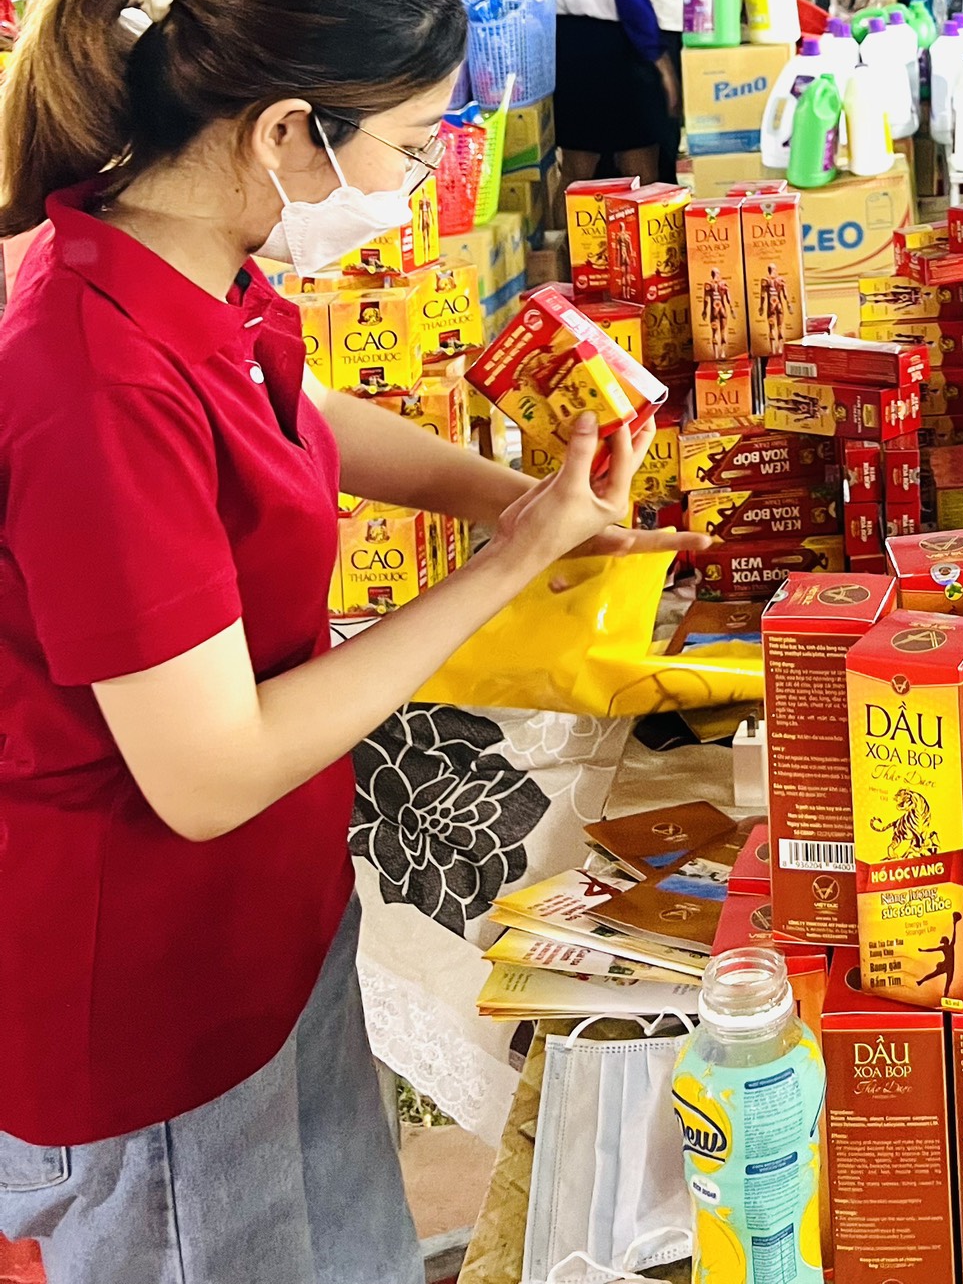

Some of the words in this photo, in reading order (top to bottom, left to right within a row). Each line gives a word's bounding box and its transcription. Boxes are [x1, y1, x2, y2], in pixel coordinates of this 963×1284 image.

[423, 295, 470, 319] CAO
[344, 330, 398, 353] CAO
[733, 452, 760, 467] BÓP
[763, 448, 789, 460] XOA
[761, 461, 790, 475] KEM
[743, 509, 770, 523] BÓP
[773, 506, 800, 517] XOA
[771, 520, 802, 532] KEM
[351, 548, 404, 570] CAO
[731, 557, 763, 570] KEM
[732, 569, 761, 583] XOA
[865, 700, 944, 749] DẦU
[865, 741, 903, 764] XOA
[907, 748, 943, 769] BÓP
[854, 1035, 911, 1064] DẦU
[853, 1066, 882, 1078] XOA
